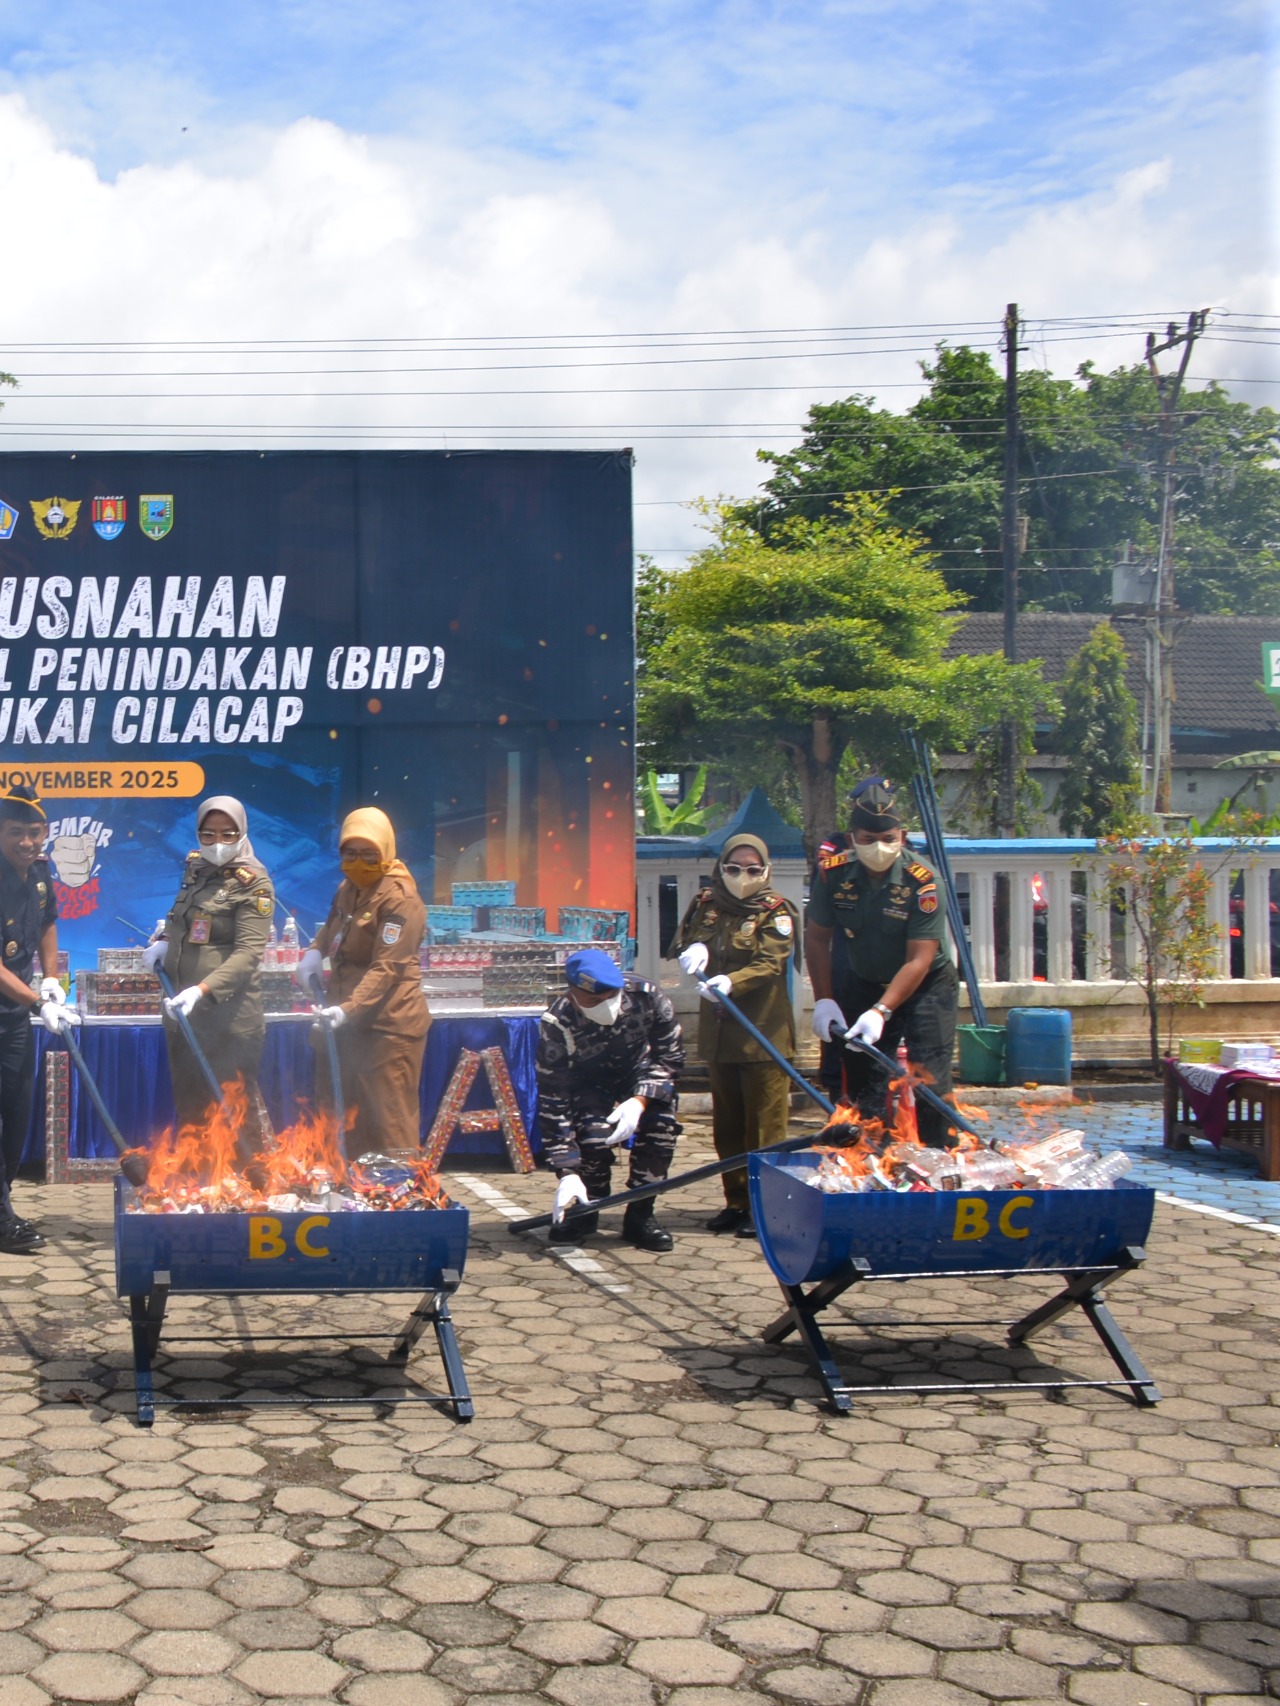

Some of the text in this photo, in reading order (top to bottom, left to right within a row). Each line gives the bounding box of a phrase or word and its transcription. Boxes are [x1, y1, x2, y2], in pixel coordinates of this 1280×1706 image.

[28, 646, 314, 692] PENINDAKAN
[326, 645, 445, 690] (BHP)
[111, 696, 304, 744] CILACAP
[121, 770, 179, 789] 2025
[248, 1215, 332, 1260] BC
[951, 1196, 1035, 1242] BC
